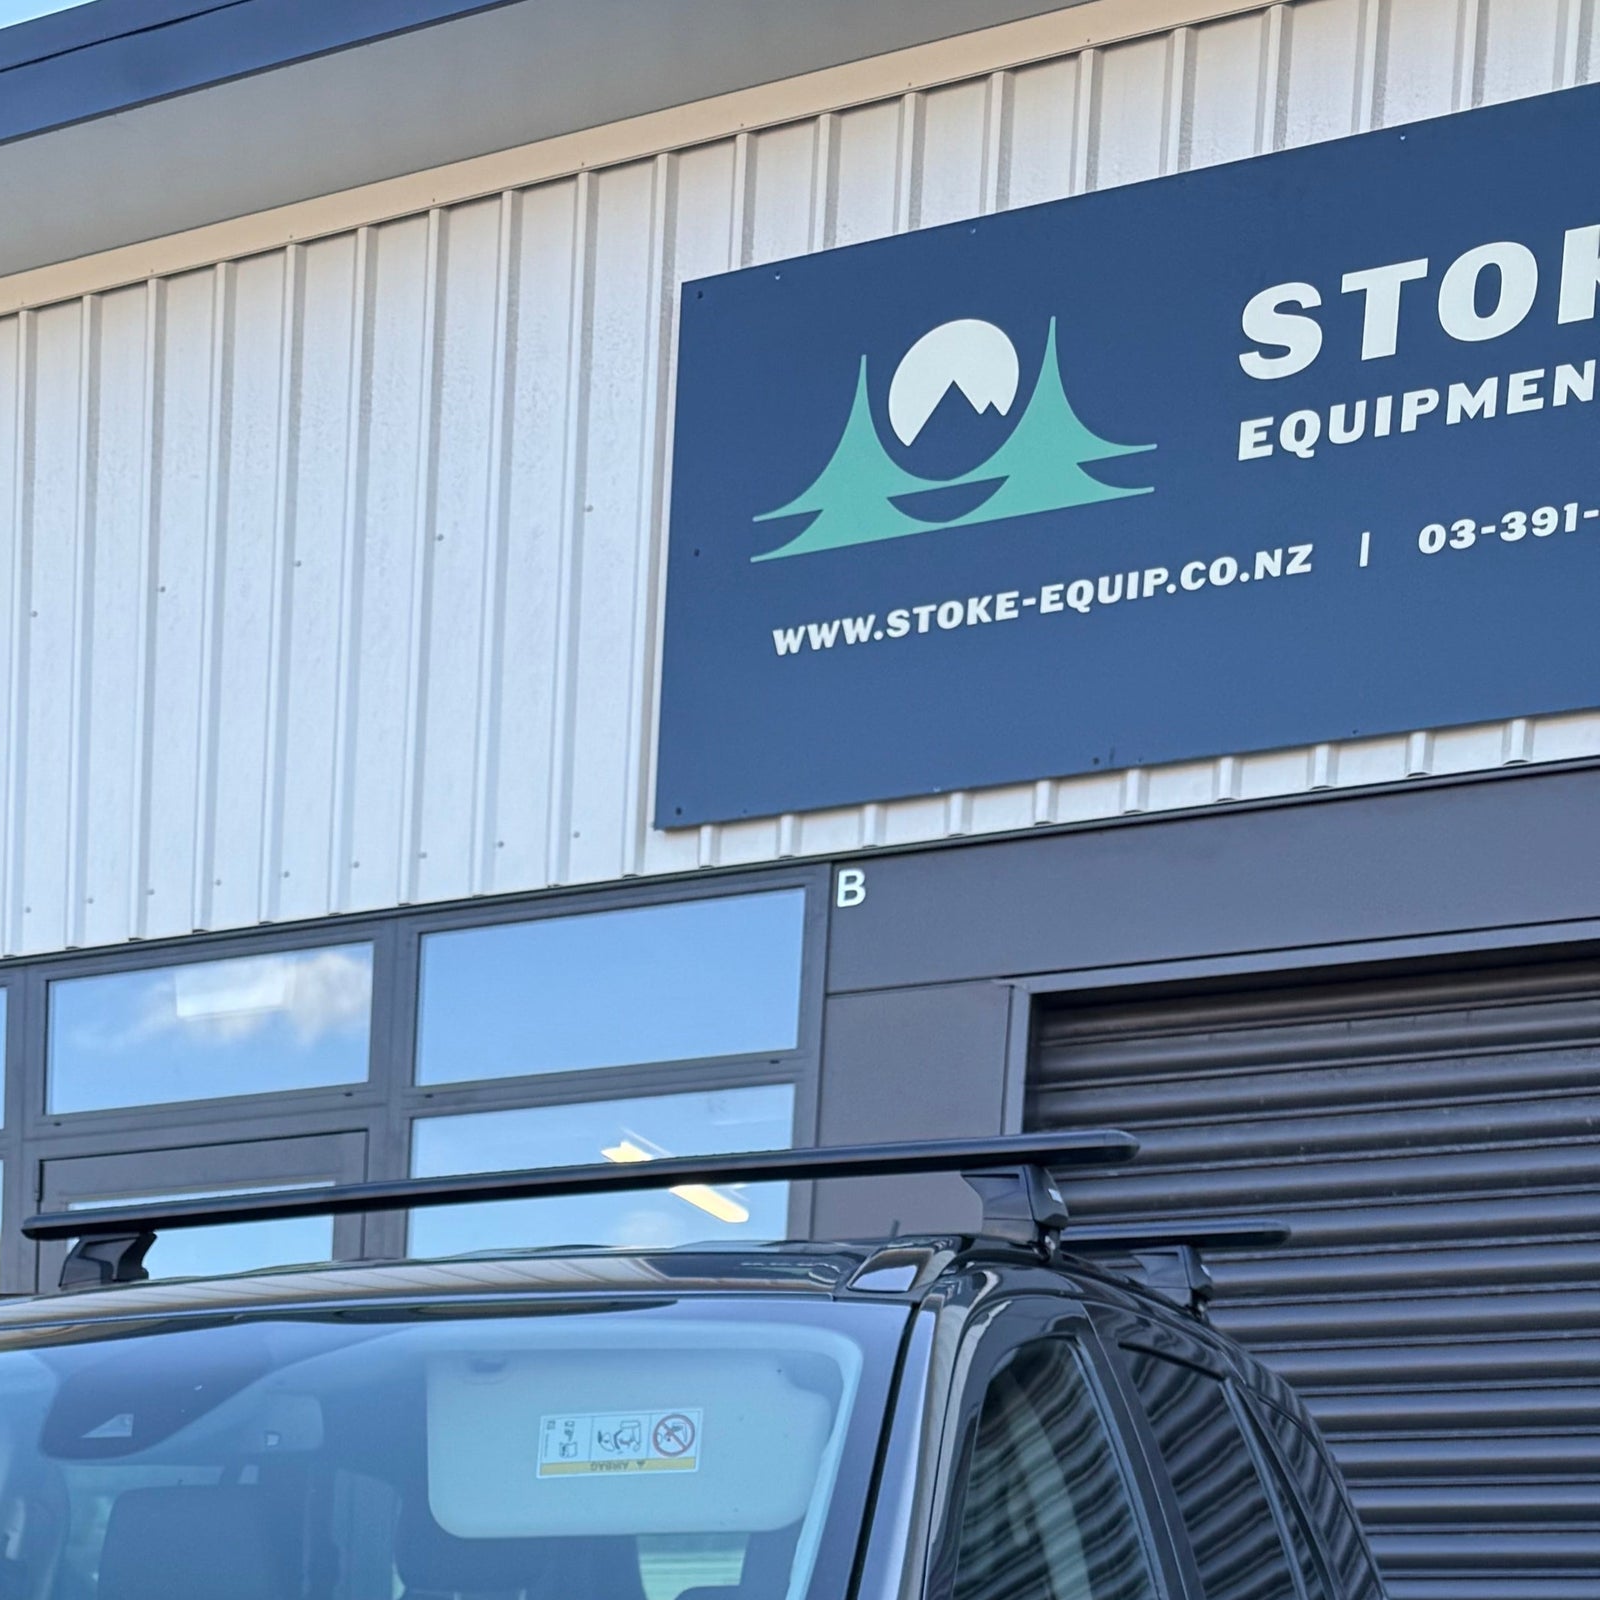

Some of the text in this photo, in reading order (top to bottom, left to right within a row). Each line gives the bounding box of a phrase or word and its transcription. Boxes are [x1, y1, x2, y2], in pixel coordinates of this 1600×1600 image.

[772, 544, 1314, 656] WWW.STOKE-EQUIP.CO.NZ
[1417, 502, 1600, 555] 03-391-
[837, 868, 867, 908] B
